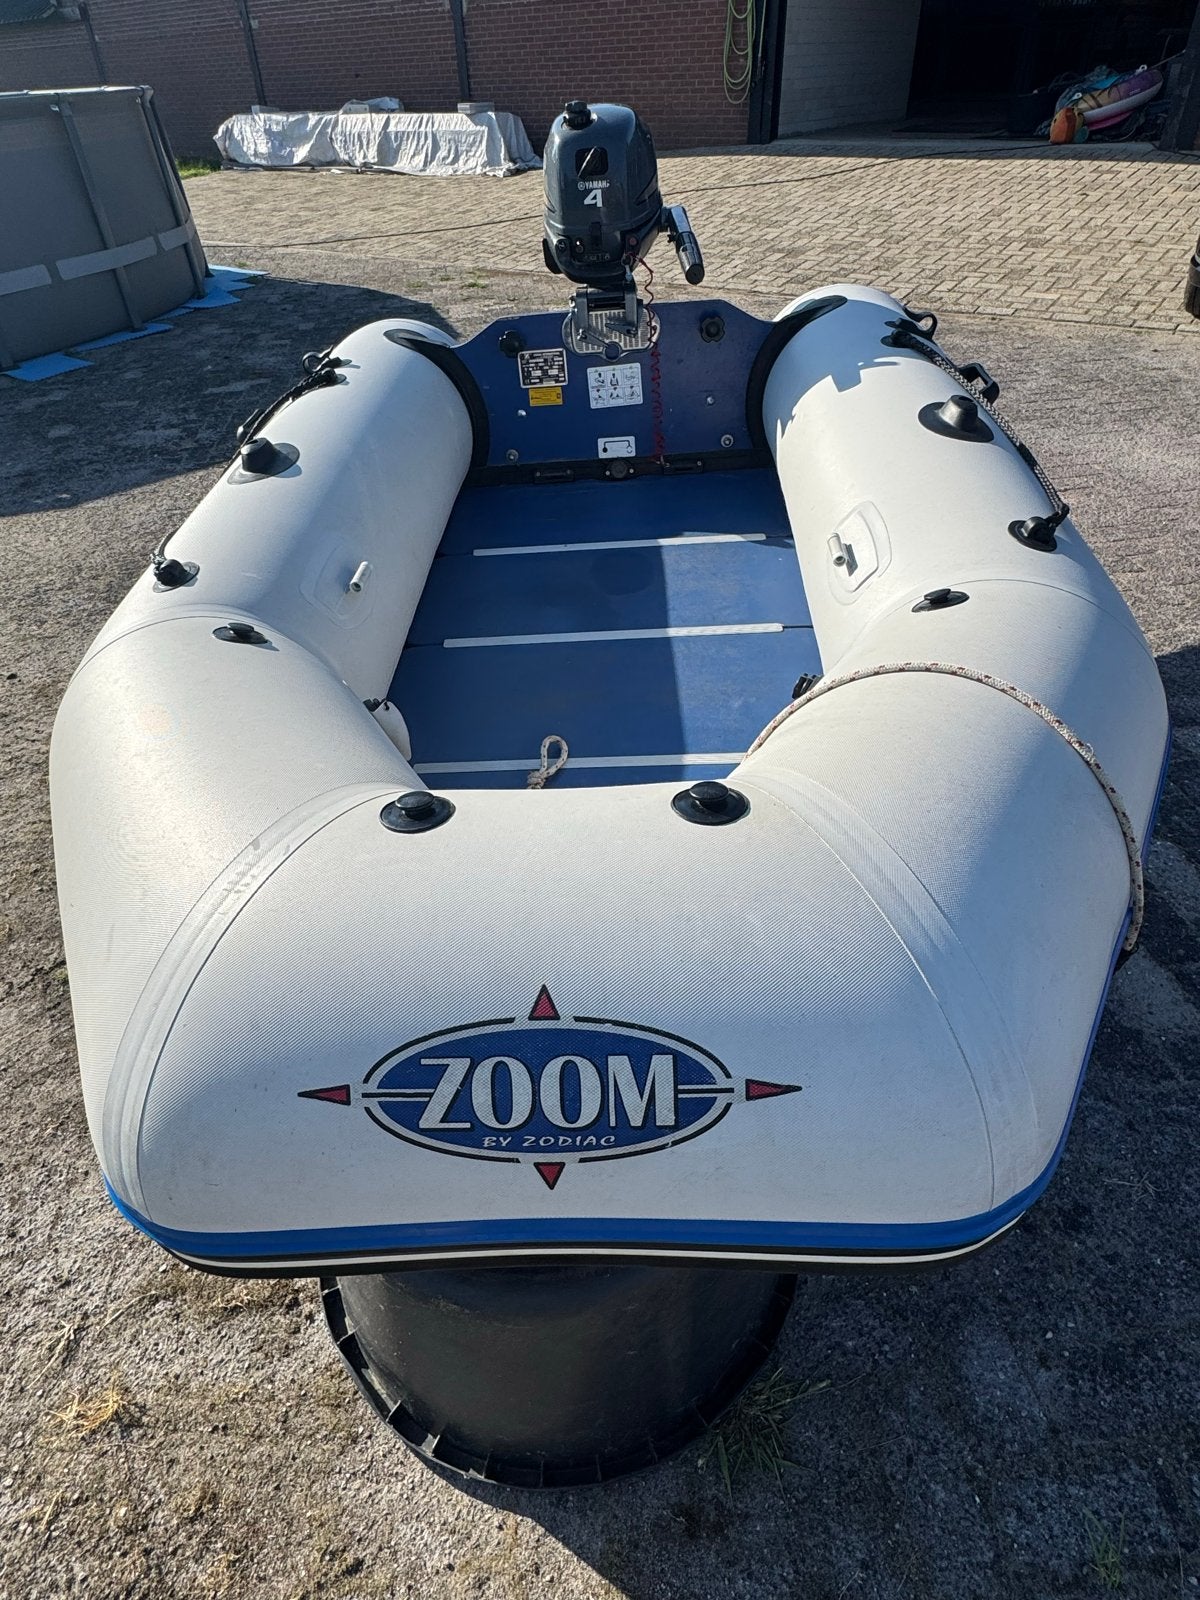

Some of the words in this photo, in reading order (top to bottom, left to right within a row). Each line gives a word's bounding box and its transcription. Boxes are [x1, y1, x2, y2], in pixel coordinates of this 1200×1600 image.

[584, 189, 603, 208] 4
[418, 1054, 676, 1130] ZOOM
[482, 1135, 512, 1147] BY
[522, 1135, 616, 1147] ZODIAC
